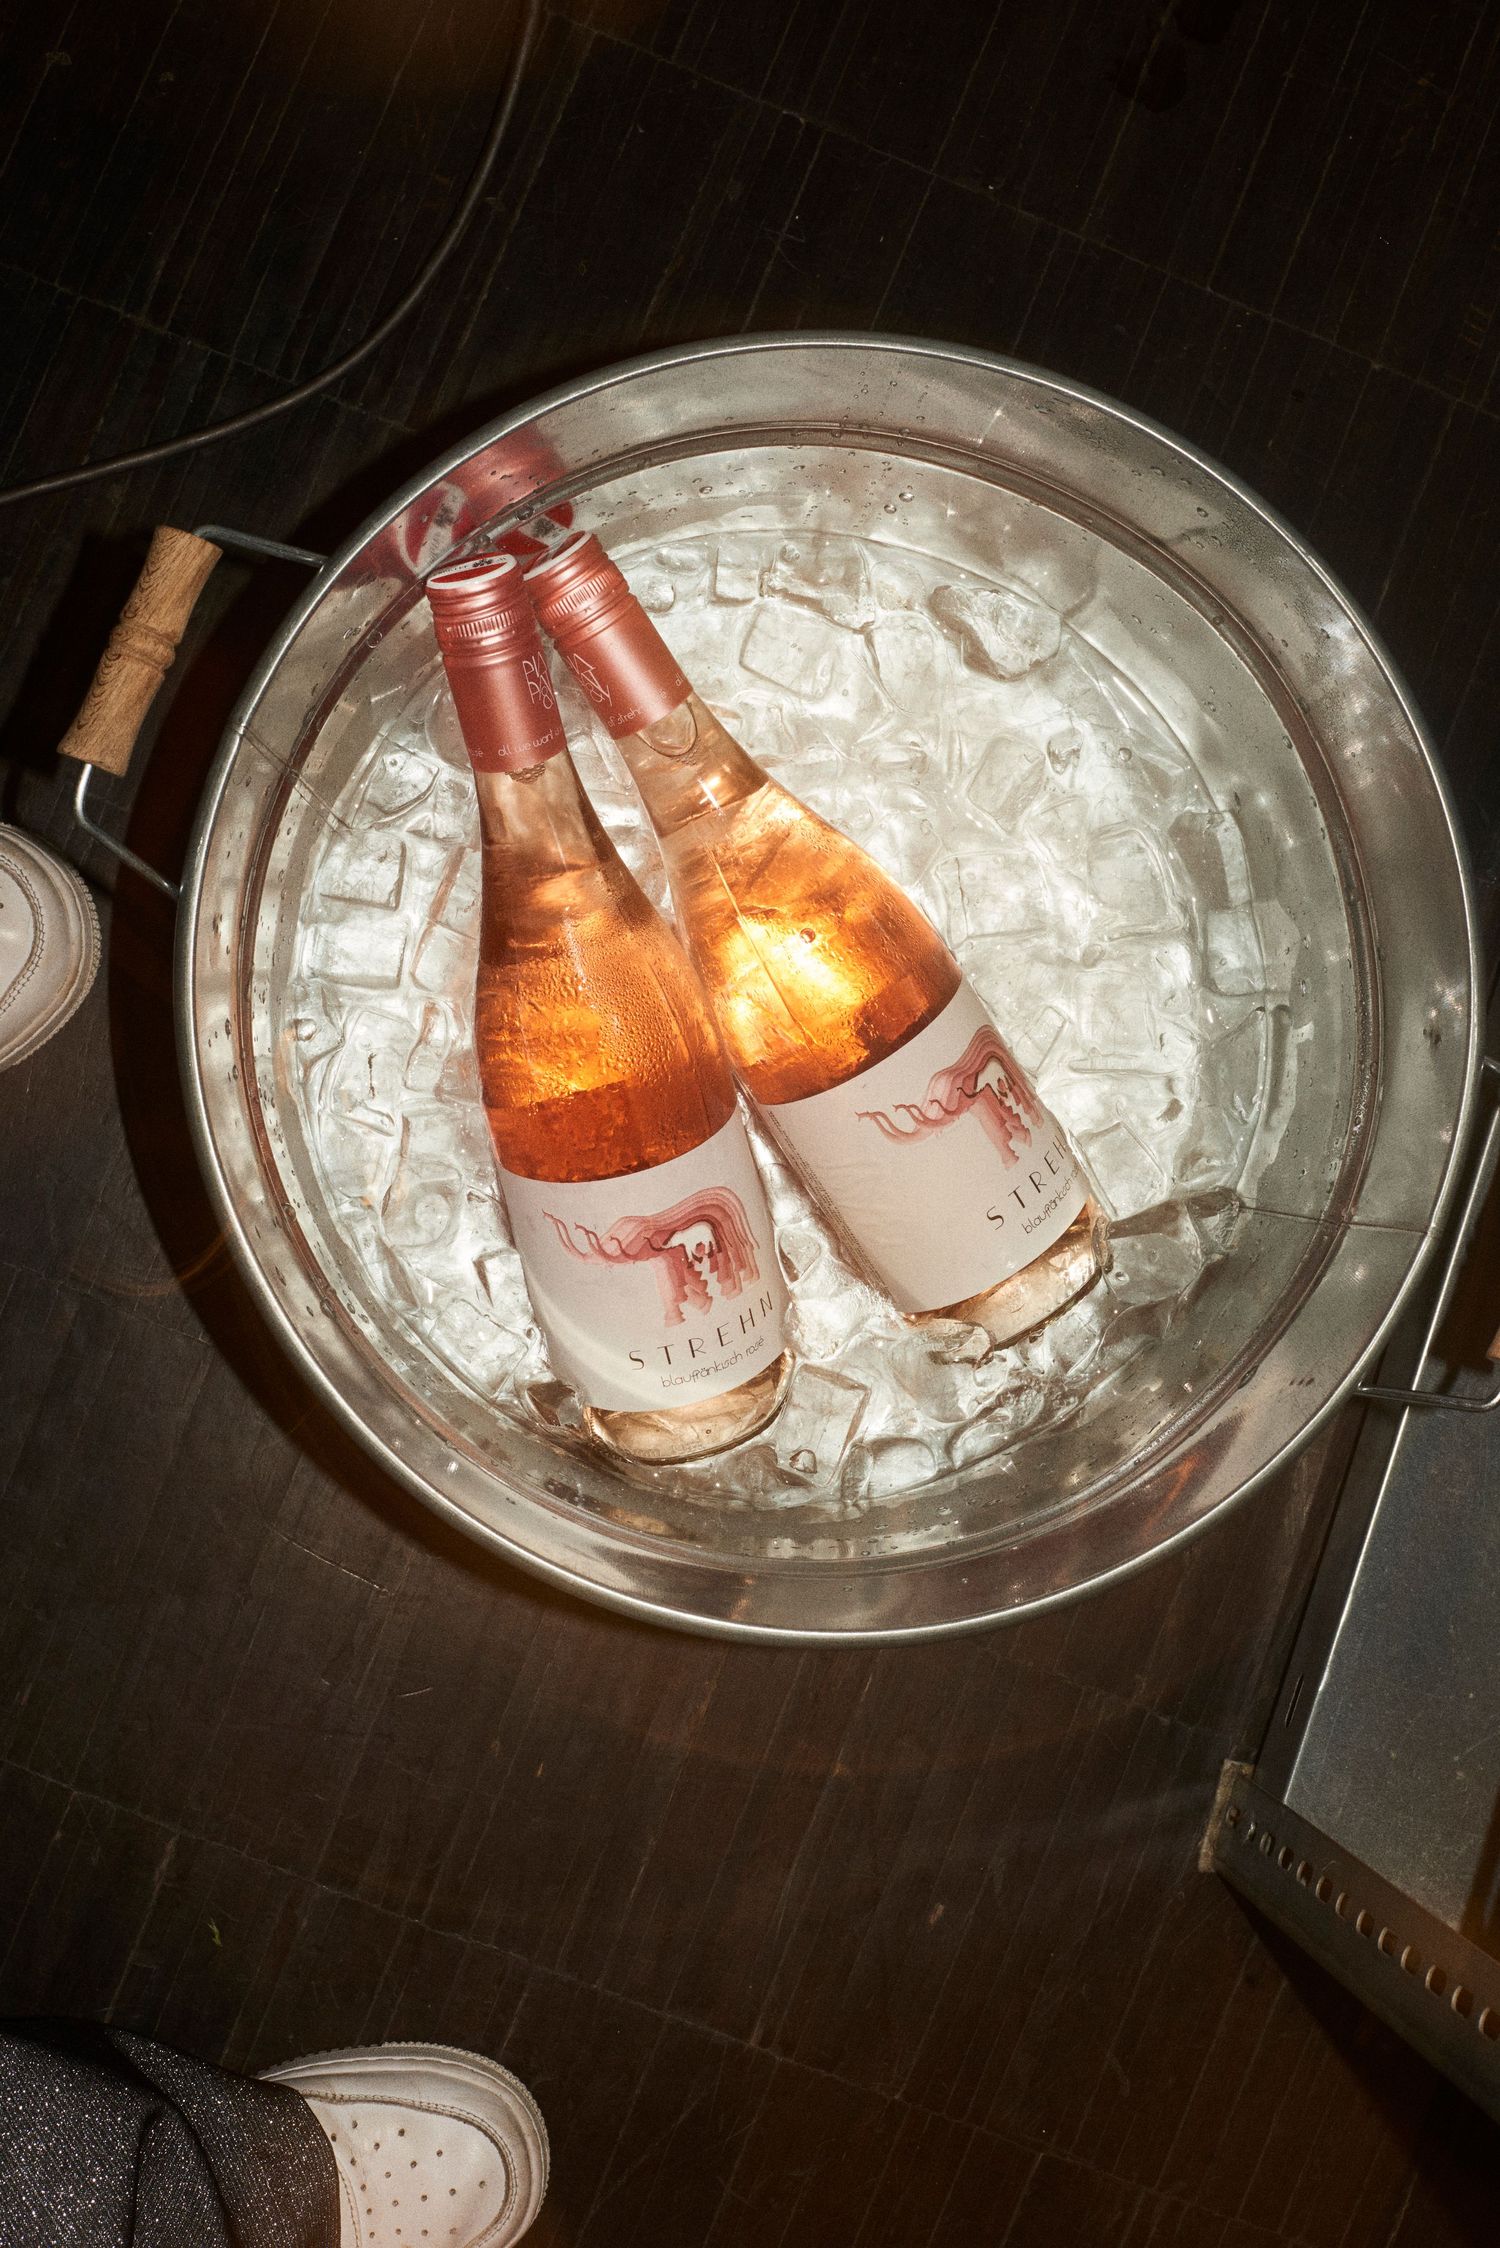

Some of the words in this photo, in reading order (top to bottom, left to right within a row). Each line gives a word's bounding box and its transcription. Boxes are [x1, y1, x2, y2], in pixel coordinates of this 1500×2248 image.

[628, 1290, 774, 1370] STREHN
[660, 1351, 743, 1388] blaufränkisch
[745, 1335, 765, 1357] rosé
